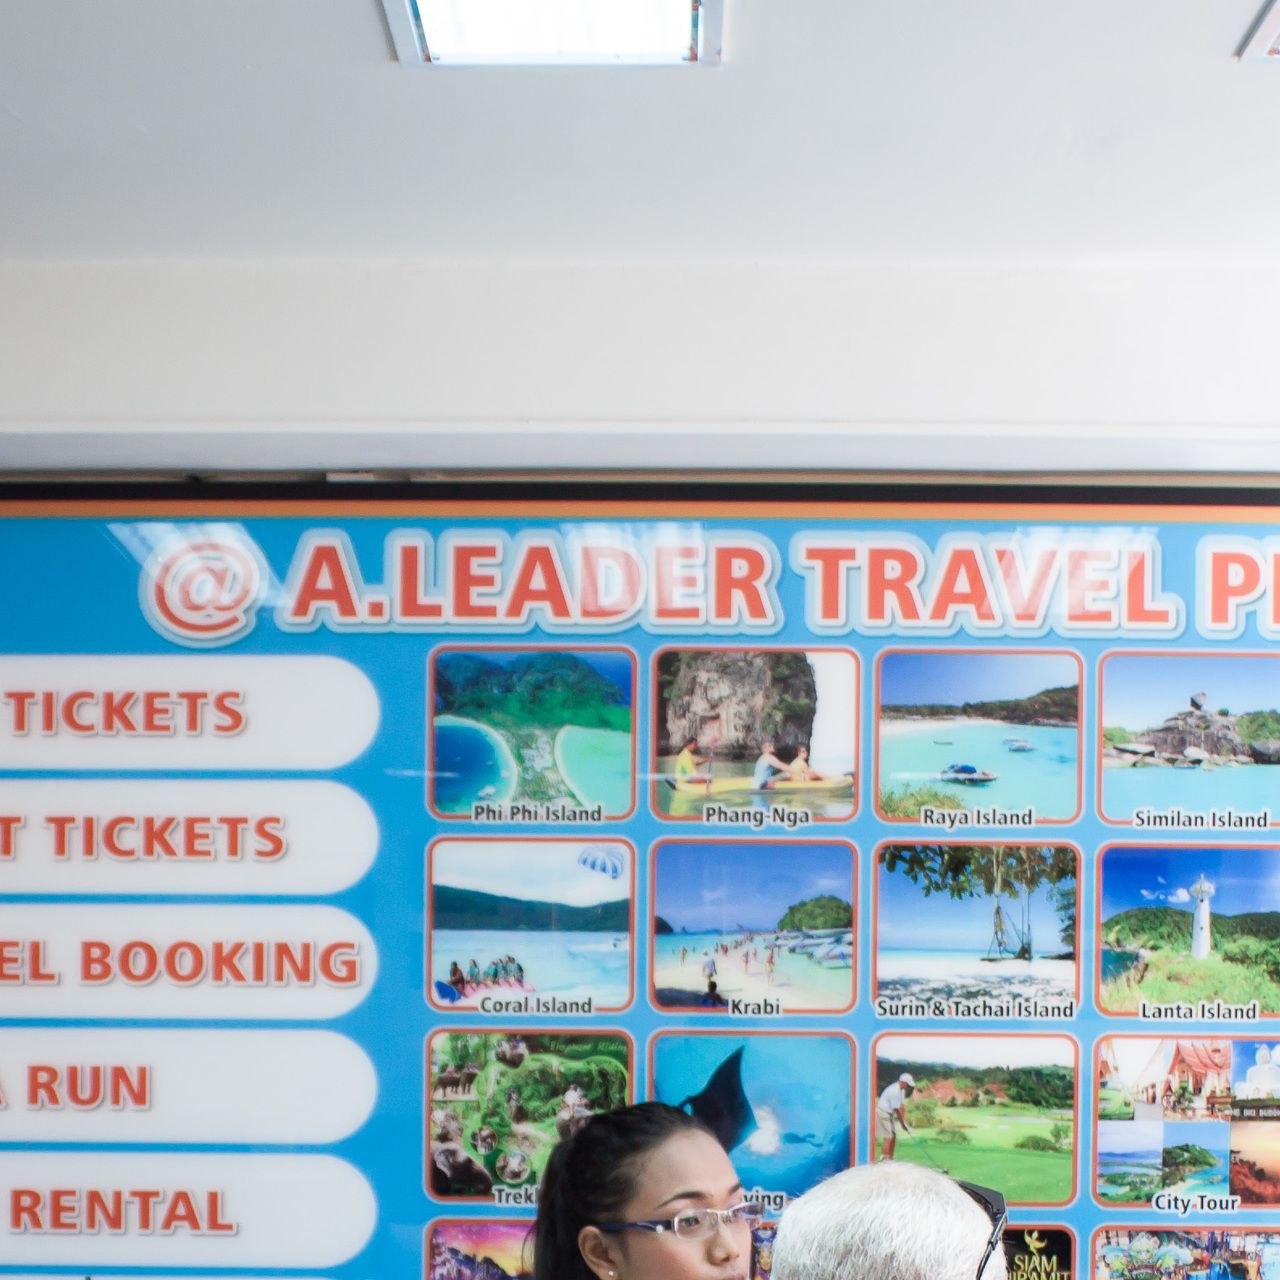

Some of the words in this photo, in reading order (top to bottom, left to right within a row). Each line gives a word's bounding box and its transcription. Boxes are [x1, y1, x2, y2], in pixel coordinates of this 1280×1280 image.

[154, 541, 250, 632] @
[290, 544, 769, 619] A.LEADER
[804, 547, 1169, 624] TRAVEL
[4, 690, 245, 734] TICKETS
[473, 805, 505, 822] Phi
[509, 805, 539, 822] Phi
[545, 805, 603, 823] Island
[705, 806, 811, 828] Phang-Nga
[923, 808, 969, 829] Raya
[976, 808, 1034, 826] Island
[1135, 810, 1206, 828] Similan
[1211, 811, 1269, 829] Island
[46, 815, 286, 859] TICKETS
[79, 940, 360, 985] BOOKING
[479, 996, 529, 1014] Coral
[535, 996, 593, 1014] Island
[731, 998, 781, 1016] Krabi
[876, 999, 926, 1018] Surin
[931, 1000, 947, 1018] &
[950, 1000, 1012, 1019] Tachai
[1017, 1000, 1075, 1019] Island
[1141, 1002, 1194, 1020] Lanta
[1199, 1002, 1258, 1021] Island
[26, 1063, 151, 1108] RUN
[10, 1188, 234, 1233] RENTAL
[1154, 1194, 1191, 1215] City
[1197, 1194, 1240, 1211] Tour
[1013, 1253, 1058, 1274] SIAM
